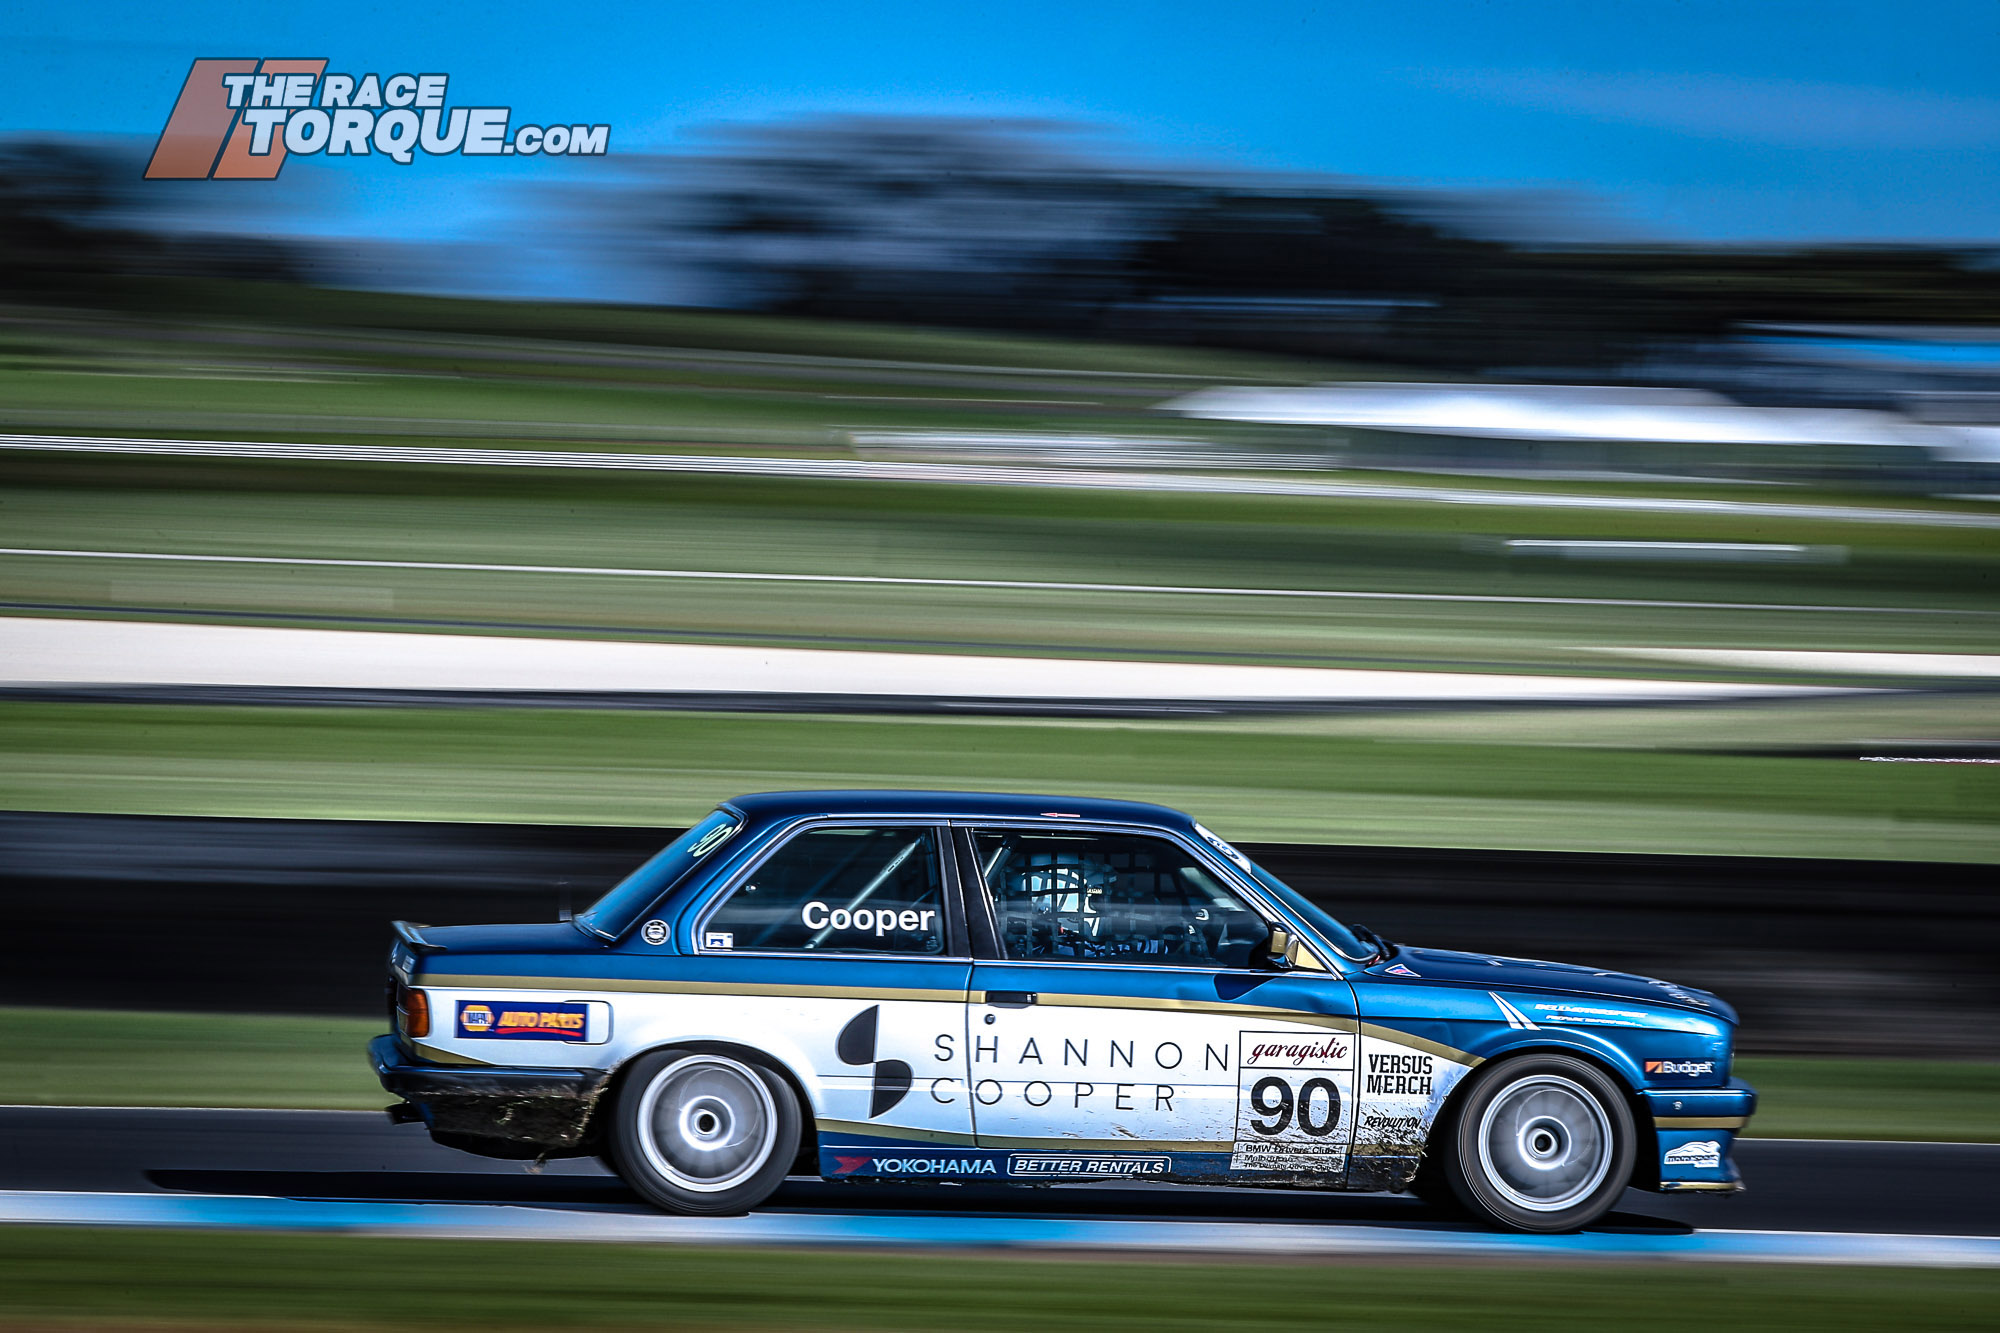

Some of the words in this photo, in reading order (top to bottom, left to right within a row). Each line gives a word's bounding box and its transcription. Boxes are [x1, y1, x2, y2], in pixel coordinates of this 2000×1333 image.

[801, 901, 936, 937] Cooper
[498, 1011, 539, 1028] AUTO
[539, 1012, 585, 1029] PARTS
[934, 1034, 1230, 1072] SHANNON
[1247, 1037, 1348, 1066] garagistic
[1368, 1053, 1434, 1075] VERSUS
[1663, 1061, 1713, 1077] Budget
[930, 1077, 1176, 1112] COOPER
[1366, 1074, 1433, 1096] MERCH
[1249, 1076, 1342, 1137] 90
[1364, 1115, 1421, 1129] REVOLUTION
[1245, 1144, 1271, 1153] BMW
[871, 1157, 997, 1174] YOKOHAMA
[1014, 1158, 1082, 1173] BETTER
[1085, 1160, 1163, 1175] RENTALS
